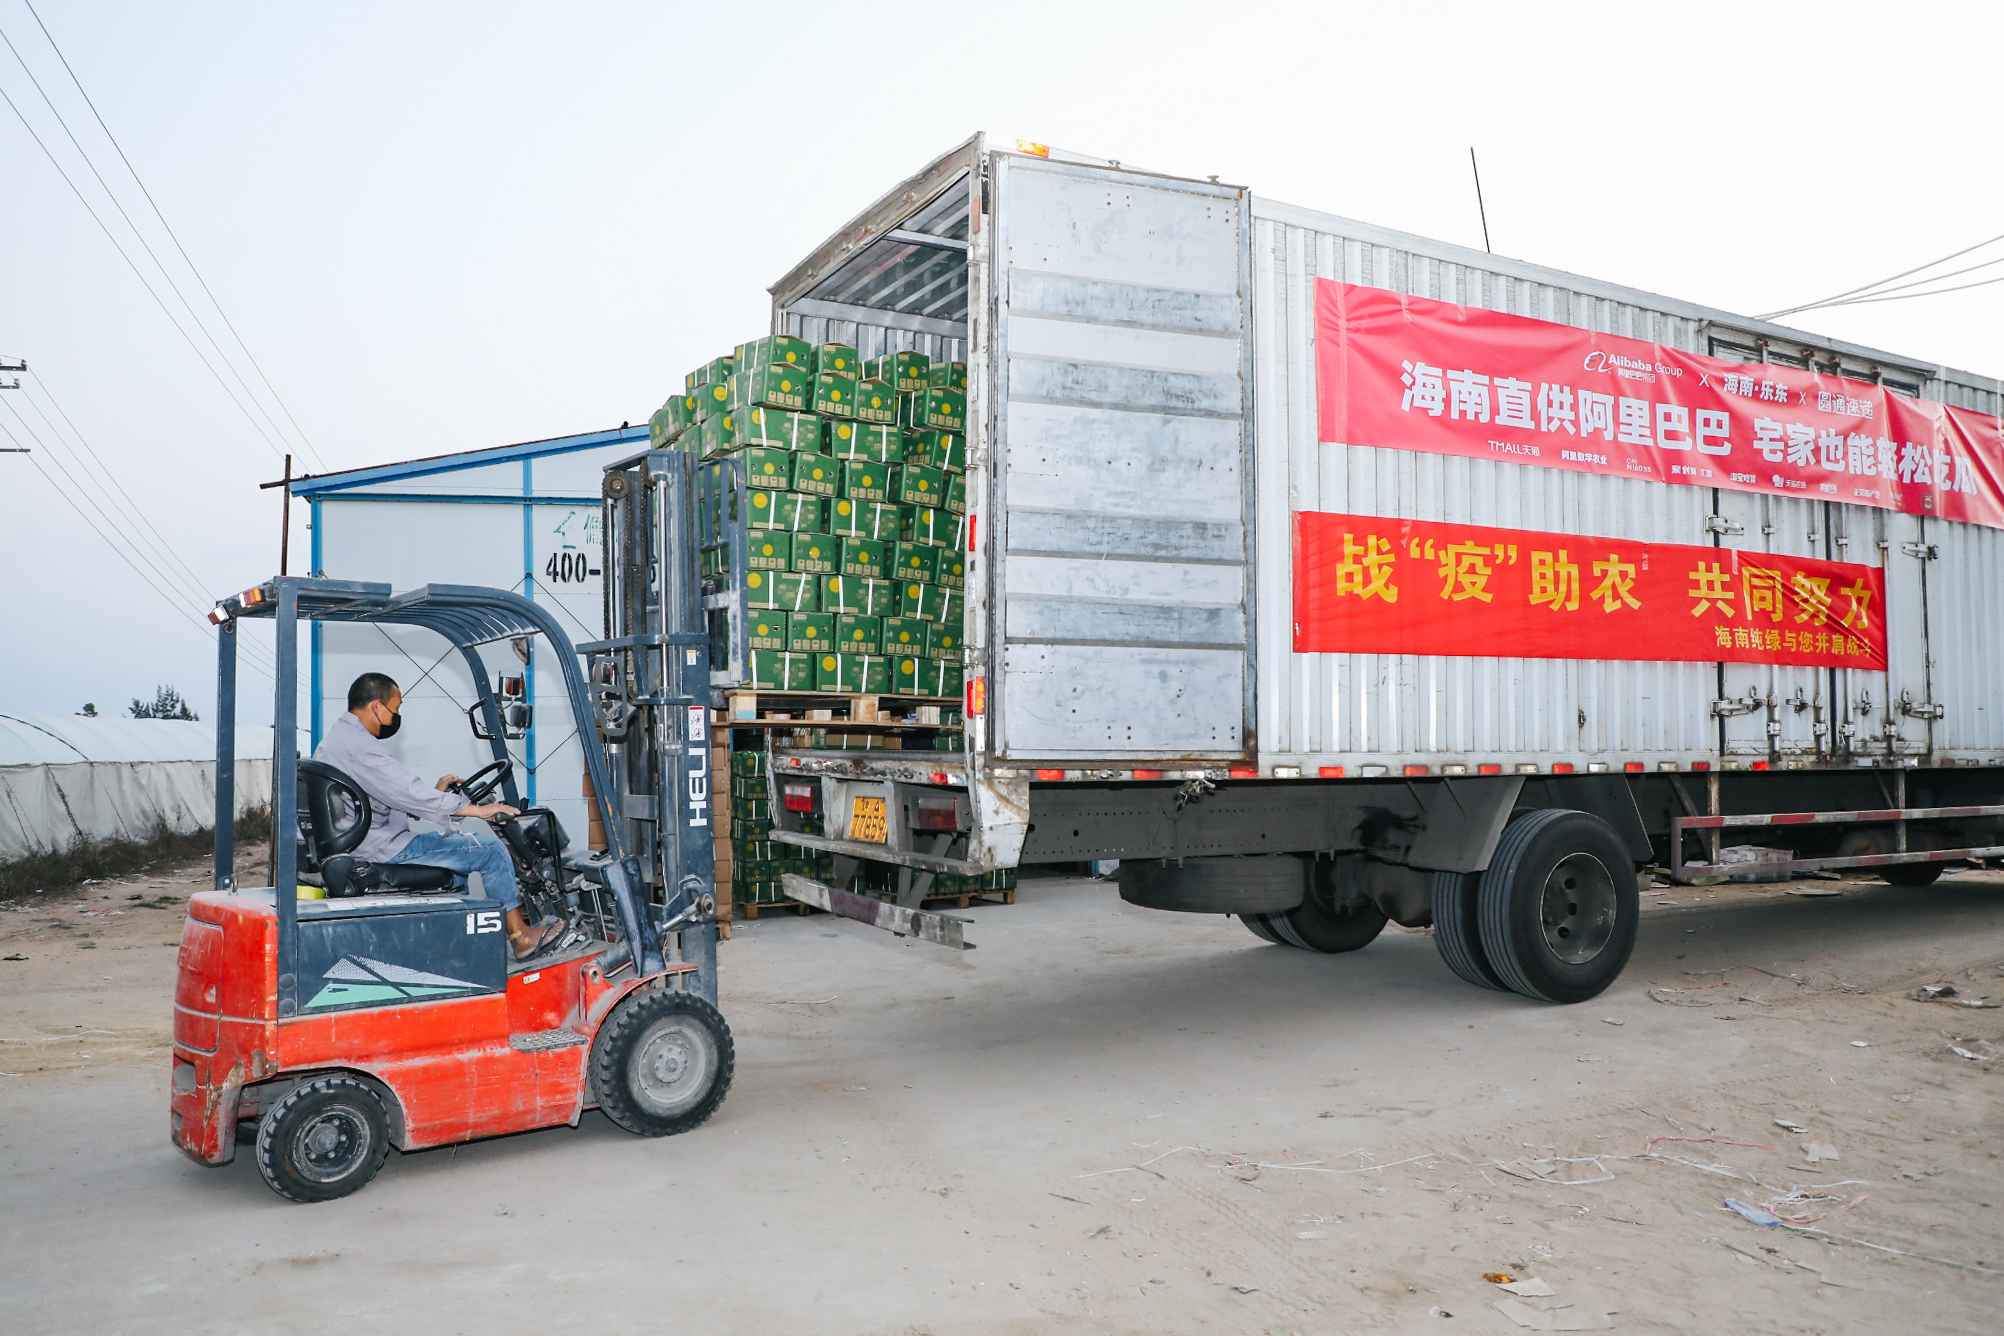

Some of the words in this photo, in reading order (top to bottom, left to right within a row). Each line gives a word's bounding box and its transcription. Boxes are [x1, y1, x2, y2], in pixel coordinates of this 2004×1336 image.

[1608, 353, 1652, 371] Alibaba
[1654, 362, 1683, 378] Group
[1818, 391, 1874, 419] 圆通速递
[1400, 358, 1732, 456] 海南直供阿里巴巴
[1753, 416, 1979, 496] 宅家也能轻松吃瓜
[1561, 449, 1608, 465] 阿里数字农业
[1688, 561, 1872, 630] 共同努力
[1714, 625, 1872, 658] 海南纯绿与您并肩战斗
[689, 748, 707, 827] HELI
[465, 911, 502, 935] 15
